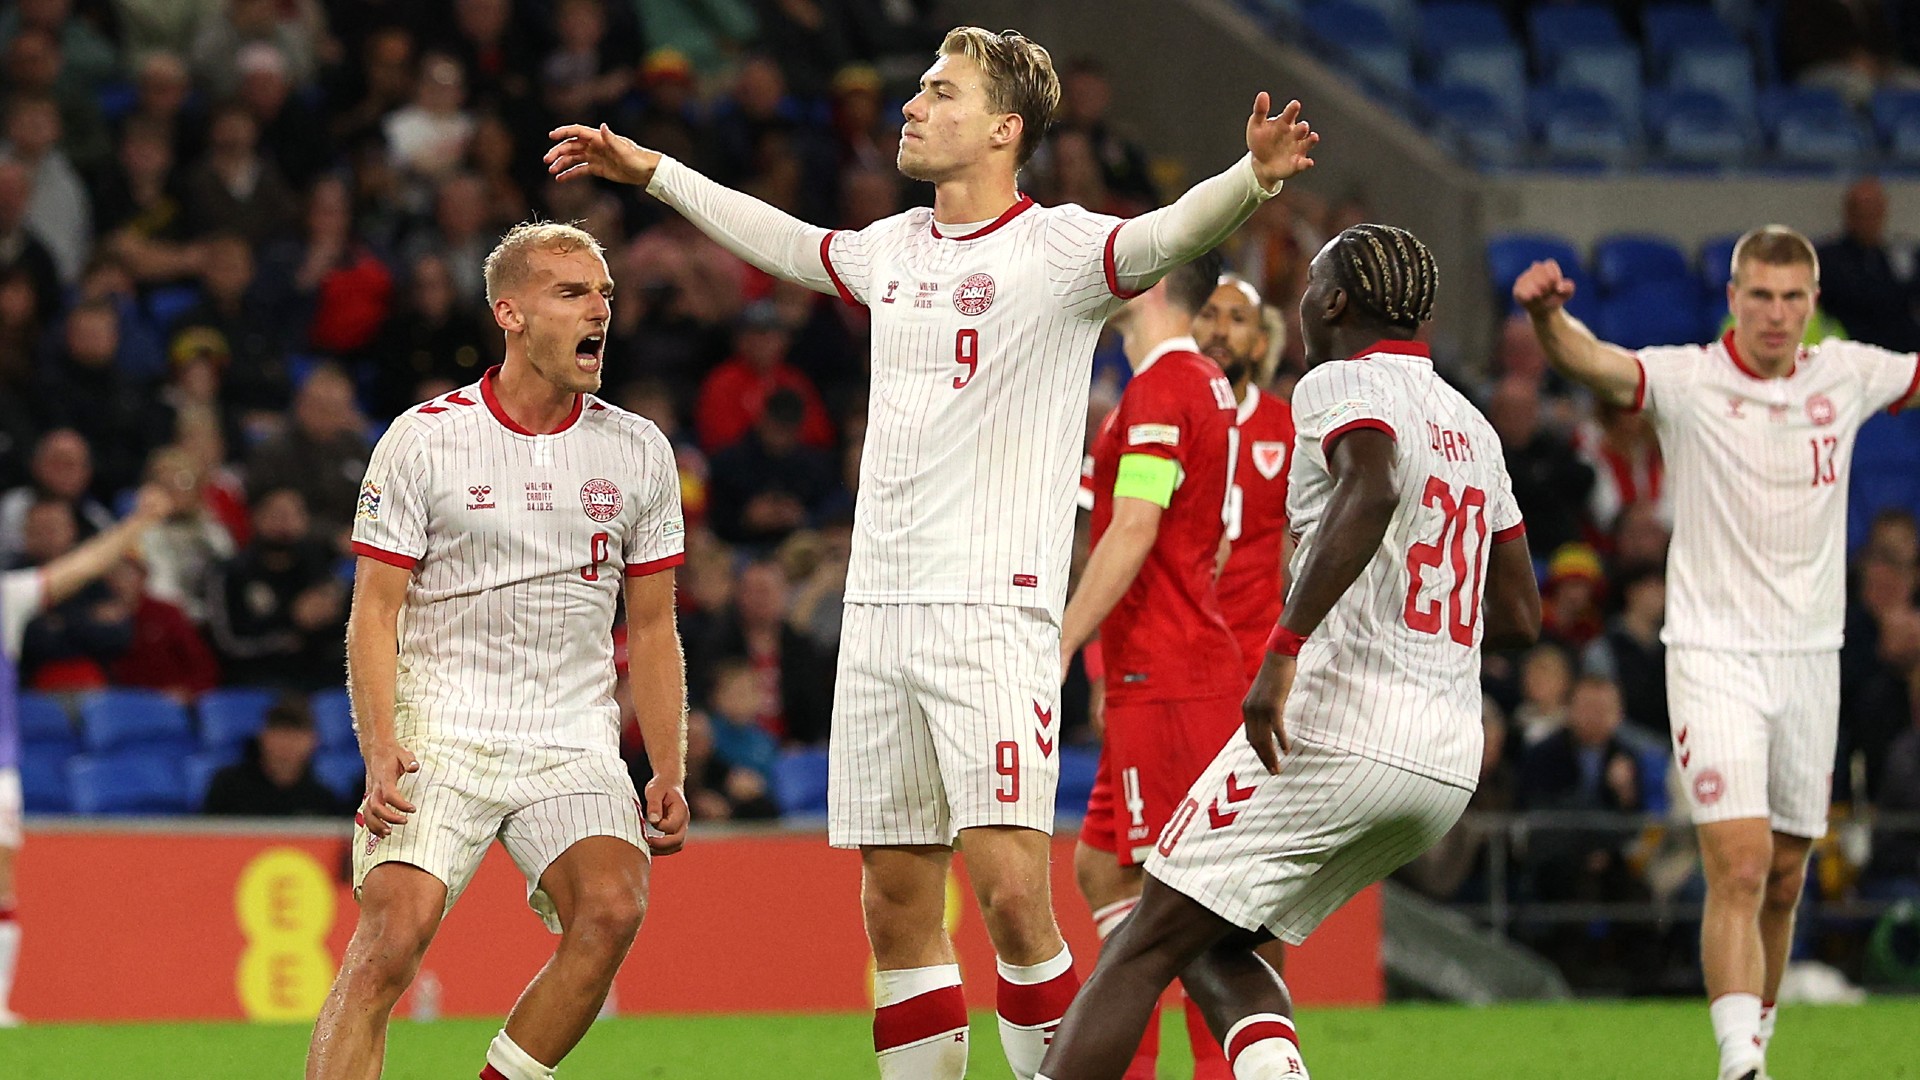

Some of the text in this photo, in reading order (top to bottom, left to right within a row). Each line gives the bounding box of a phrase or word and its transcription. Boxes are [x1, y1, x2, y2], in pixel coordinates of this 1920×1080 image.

[961, 286, 987, 299] DBU
[952, 328, 979, 390] 9
[524, 481, 553, 491] WAL-DEN
[1810, 436, 1837, 487] 13
[526, 492, 552, 501] CARDIFF
[590, 492, 615, 506] DBU
[1403, 475, 1486, 648] 20
[995, 740, 1020, 803] 9
[1121, 766, 1145, 826] 4
